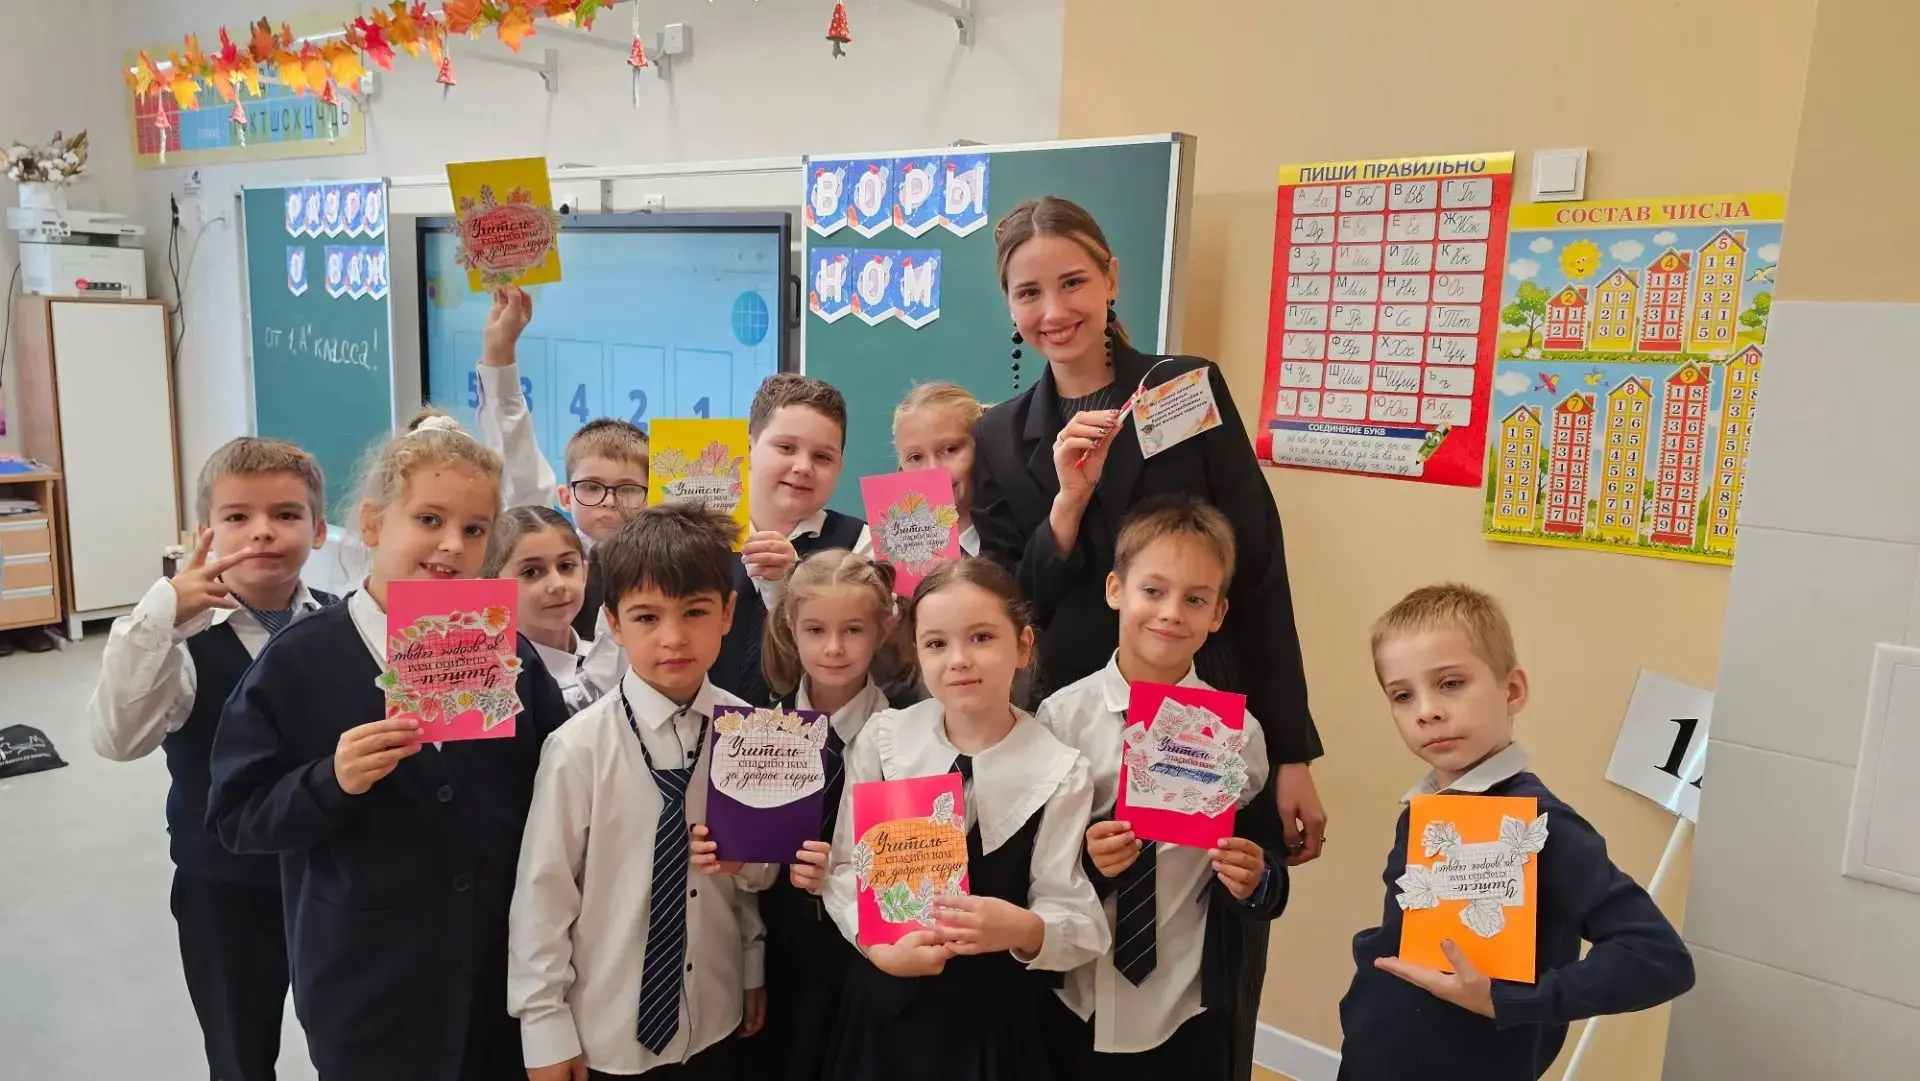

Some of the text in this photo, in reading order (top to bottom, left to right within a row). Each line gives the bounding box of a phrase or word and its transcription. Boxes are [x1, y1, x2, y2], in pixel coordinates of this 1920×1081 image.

[1299, 159, 1486, 183] ПИШИ ПРАВИЛЬНО
[1344, 186, 1352, 198] Б
[1394, 183, 1402, 195] В
[1446, 181, 1455, 192] Г
[1298, 189, 1306, 199] А
[1556, 201, 1751, 224] СОСТАВ ЧИСЛА
[1295, 218, 1304, 231] Д
[1343, 217, 1350, 228] Е
[1444, 213, 1456, 225] Ж
[1441, 244, 1450, 256] К
[1719, 239, 1728, 250] 5
[1294, 247, 1301, 258] З
[1340, 247, 1349, 258] И
[1390, 244, 1399, 257] Й
[1707, 257, 1735, 267] 1 4
[820, 258, 932, 308] НОМ
[1290, 276, 1299, 288] Л
[1337, 276, 1347, 288] М
[1387, 276, 1397, 287] Н
[1438, 275, 1449, 287] О
[1614, 275, 1622, 287] 3
[1655, 275, 1681, 285] 1 3
[1705, 275, 1732, 285] 2 3
[1564, 291, 1573, 302] 2
[1604, 293, 1629, 303] 1 2
[1652, 293, 1679, 303] 2 2
[1703, 292, 1730, 303] 3 2
[1290, 306, 1298, 317] П
[1336, 306, 1344, 317] Р
[1384, 305, 1393, 318] С
[1437, 306, 1446, 318] Т
[1555, 310, 1578, 319] 1 1
[1601, 310, 1626, 320] 2 1
[1649, 310, 1676, 319] 3 1
[1701, 310, 1727, 320] 4 1
[1552, 326, 1578, 336] 2 0
[1599, 326, 1625, 336] 3 0
[1648, 326, 1675, 336] 4 0
[1699, 327, 1726, 337] 5 0
[1288, 334, 1295, 345] У
[1332, 336, 1340, 345] Ф
[1381, 336, 1390, 348] Х
[1432, 337, 1442, 351] Ц
[1285, 363, 1292, 374] Ч
[1330, 365, 1339, 376] Ш
[1377, 366, 1388, 379] Щ
[1626, 384, 1635, 395] 8
[1327, 394, 1335, 404] Э
[1374, 395, 1386, 408] Ю
[1424, 399, 1435, 410] Я
[569, 383, 590, 423] 4
[627, 389, 648, 430] 2
[693, 396, 710, 420] 1
[1517, 411, 1526, 422] 6
[1308, 423, 1386, 436] СОЕДИНЕНИЕ БУКВ
[440, 633, 487, 657] доброе
[486, 632, 505, 651] за
[435, 657, 487, 671] спасибо
[1653, 718, 1703, 790] 1
[738, 758, 808, 769] спасибо вам
[719, 772, 824, 790] за доброе сердце!
[885, 850, 953, 863] спасибо вам
[1471, 852, 1504, 870] доброе
[869, 870, 887, 887] за
[886, 865, 926, 887] доброе
